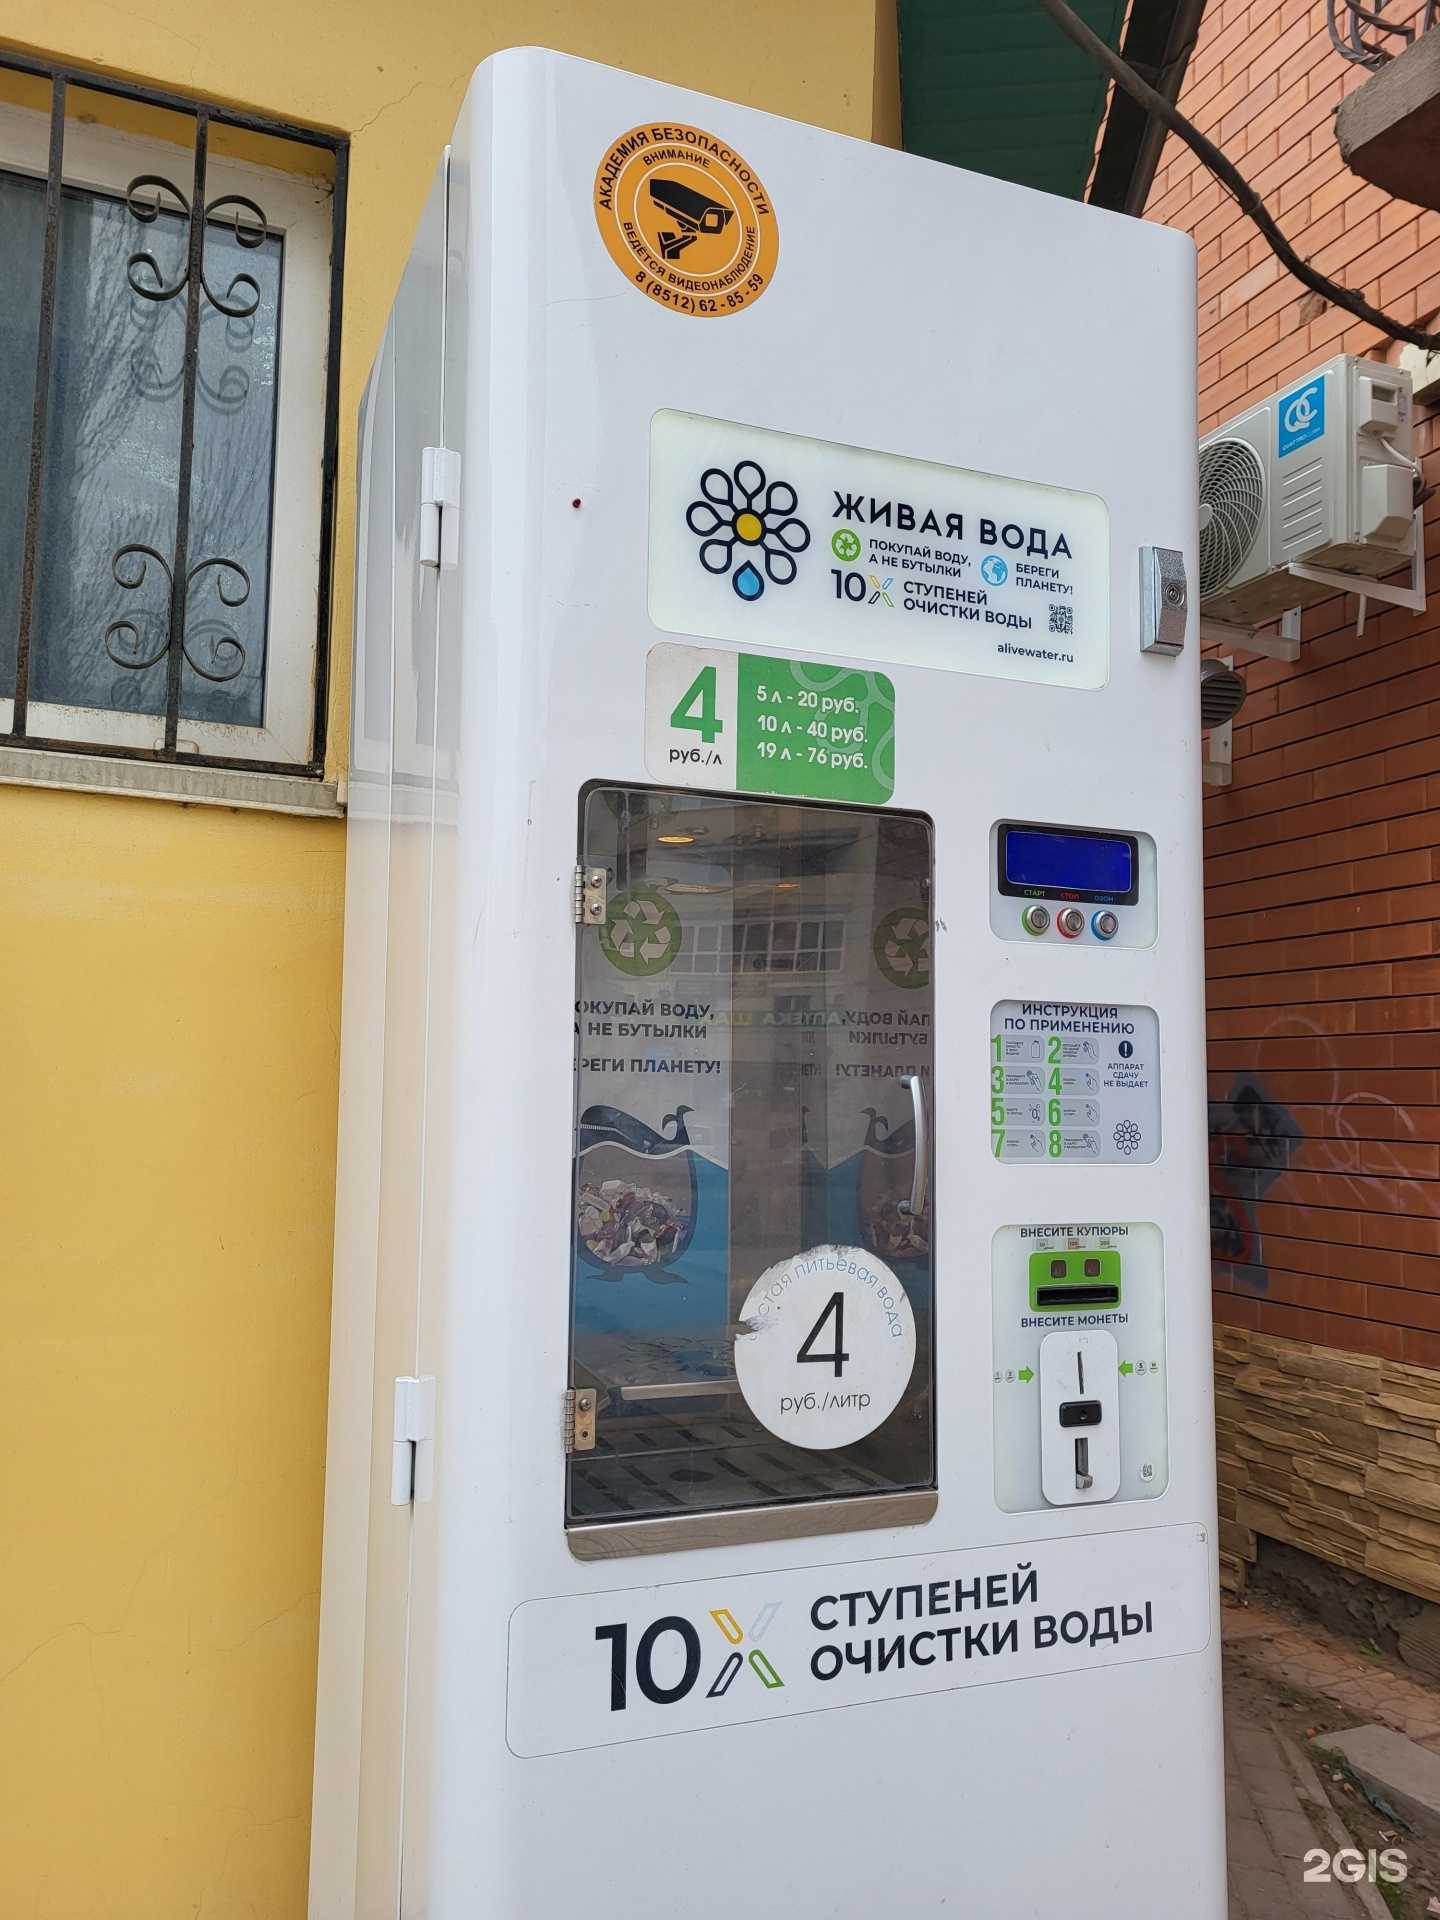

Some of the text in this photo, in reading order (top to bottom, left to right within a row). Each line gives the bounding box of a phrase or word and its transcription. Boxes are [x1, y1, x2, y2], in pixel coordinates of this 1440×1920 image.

[600, 128, 769, 215] АКАДЕМИЯ БЕЗОПАСНОСТИ
[643, 149, 710, 168] ВНИМАНИЕ
[624, 222, 755, 291] ВЕДЁТСЯ ВИДЕОНАБЛЮДЕНИЕ
[635, 271, 646, 283] 8
[646, 280, 696, 314] (8512)
[832, 491, 1072, 559] ЖИВАЯ ВОДА
[869, 538, 971, 567] ПОКУПАЙ ВОДУ,
[869, 554, 961, 578] А НЕ БУТЫЛКИ
[1016, 563, 1059, 579] БЕРЕГИ
[903, 581, 988, 605] СТУПЕНЕЙ
[1016, 577, 1073, 595] ПЛАНЕТУ!
[903, 598, 1032, 629] ОЧИСТКИ ВОДЫ
[997, 642, 1074, 663] alivewater.ru
[670, 666, 723, 743] 4
[756, 685, 767, 702] 5
[771, 692, 782, 704] л
[798, 691, 817, 708] 20
[821, 697, 859, 714] руб.
[757, 715, 777, 732] 10
[781, 722, 792, 735] л
[806, 721, 828, 738] 40
[831, 726, 868, 743] руб.
[669, 748, 722, 766] руб./л
[757, 742, 776, 759] 19
[780, 748, 792, 761] л
[808, 747, 827, 765] 76
[831, 752, 868, 769] руб.
[661, 1004, 714, 1020] ВОДУ,
[1022, 1003, 1118, 1020] ИНСТРУКЦИЯ
[588, 1023, 612, 1036] НЕ
[618, 1023, 707, 1039] БУТЫЛКИ
[1004, 1018, 1135, 1034] ПО ПРИМЕНЕНИЮ
[991, 1034, 1002, 1062] 1
[1048, 1036, 1061, 1064] 2
[631, 1059, 721, 1074] ПЛАНЕТУ!
[991, 1066, 1004, 1094] 3
[1048, 1067, 1062, 1095] 4
[991, 1098, 1005, 1125] 5
[1048, 1099, 1061, 1126] 6
[991, 1129, 1005, 1157] 7
[1049, 1130, 1061, 1158] 8
[1020, 1226, 1129, 1238] ВНЕСИТЕ КУПЮРЫ
[794, 1256, 879, 1289] питьевая
[877, 1286, 903, 1338] вода
[1021, 1313, 1128, 1328] ВНЕСИТЕ МОНЕТЫ
[797, 1292, 850, 1378] 4
[780, 1391, 871, 1415] руб./литр
[810, 1561, 1038, 1631] СТУПЕНЕЙ
[810, 1601, 1153, 1681] ОЧИСТКИ ВОДЫ
